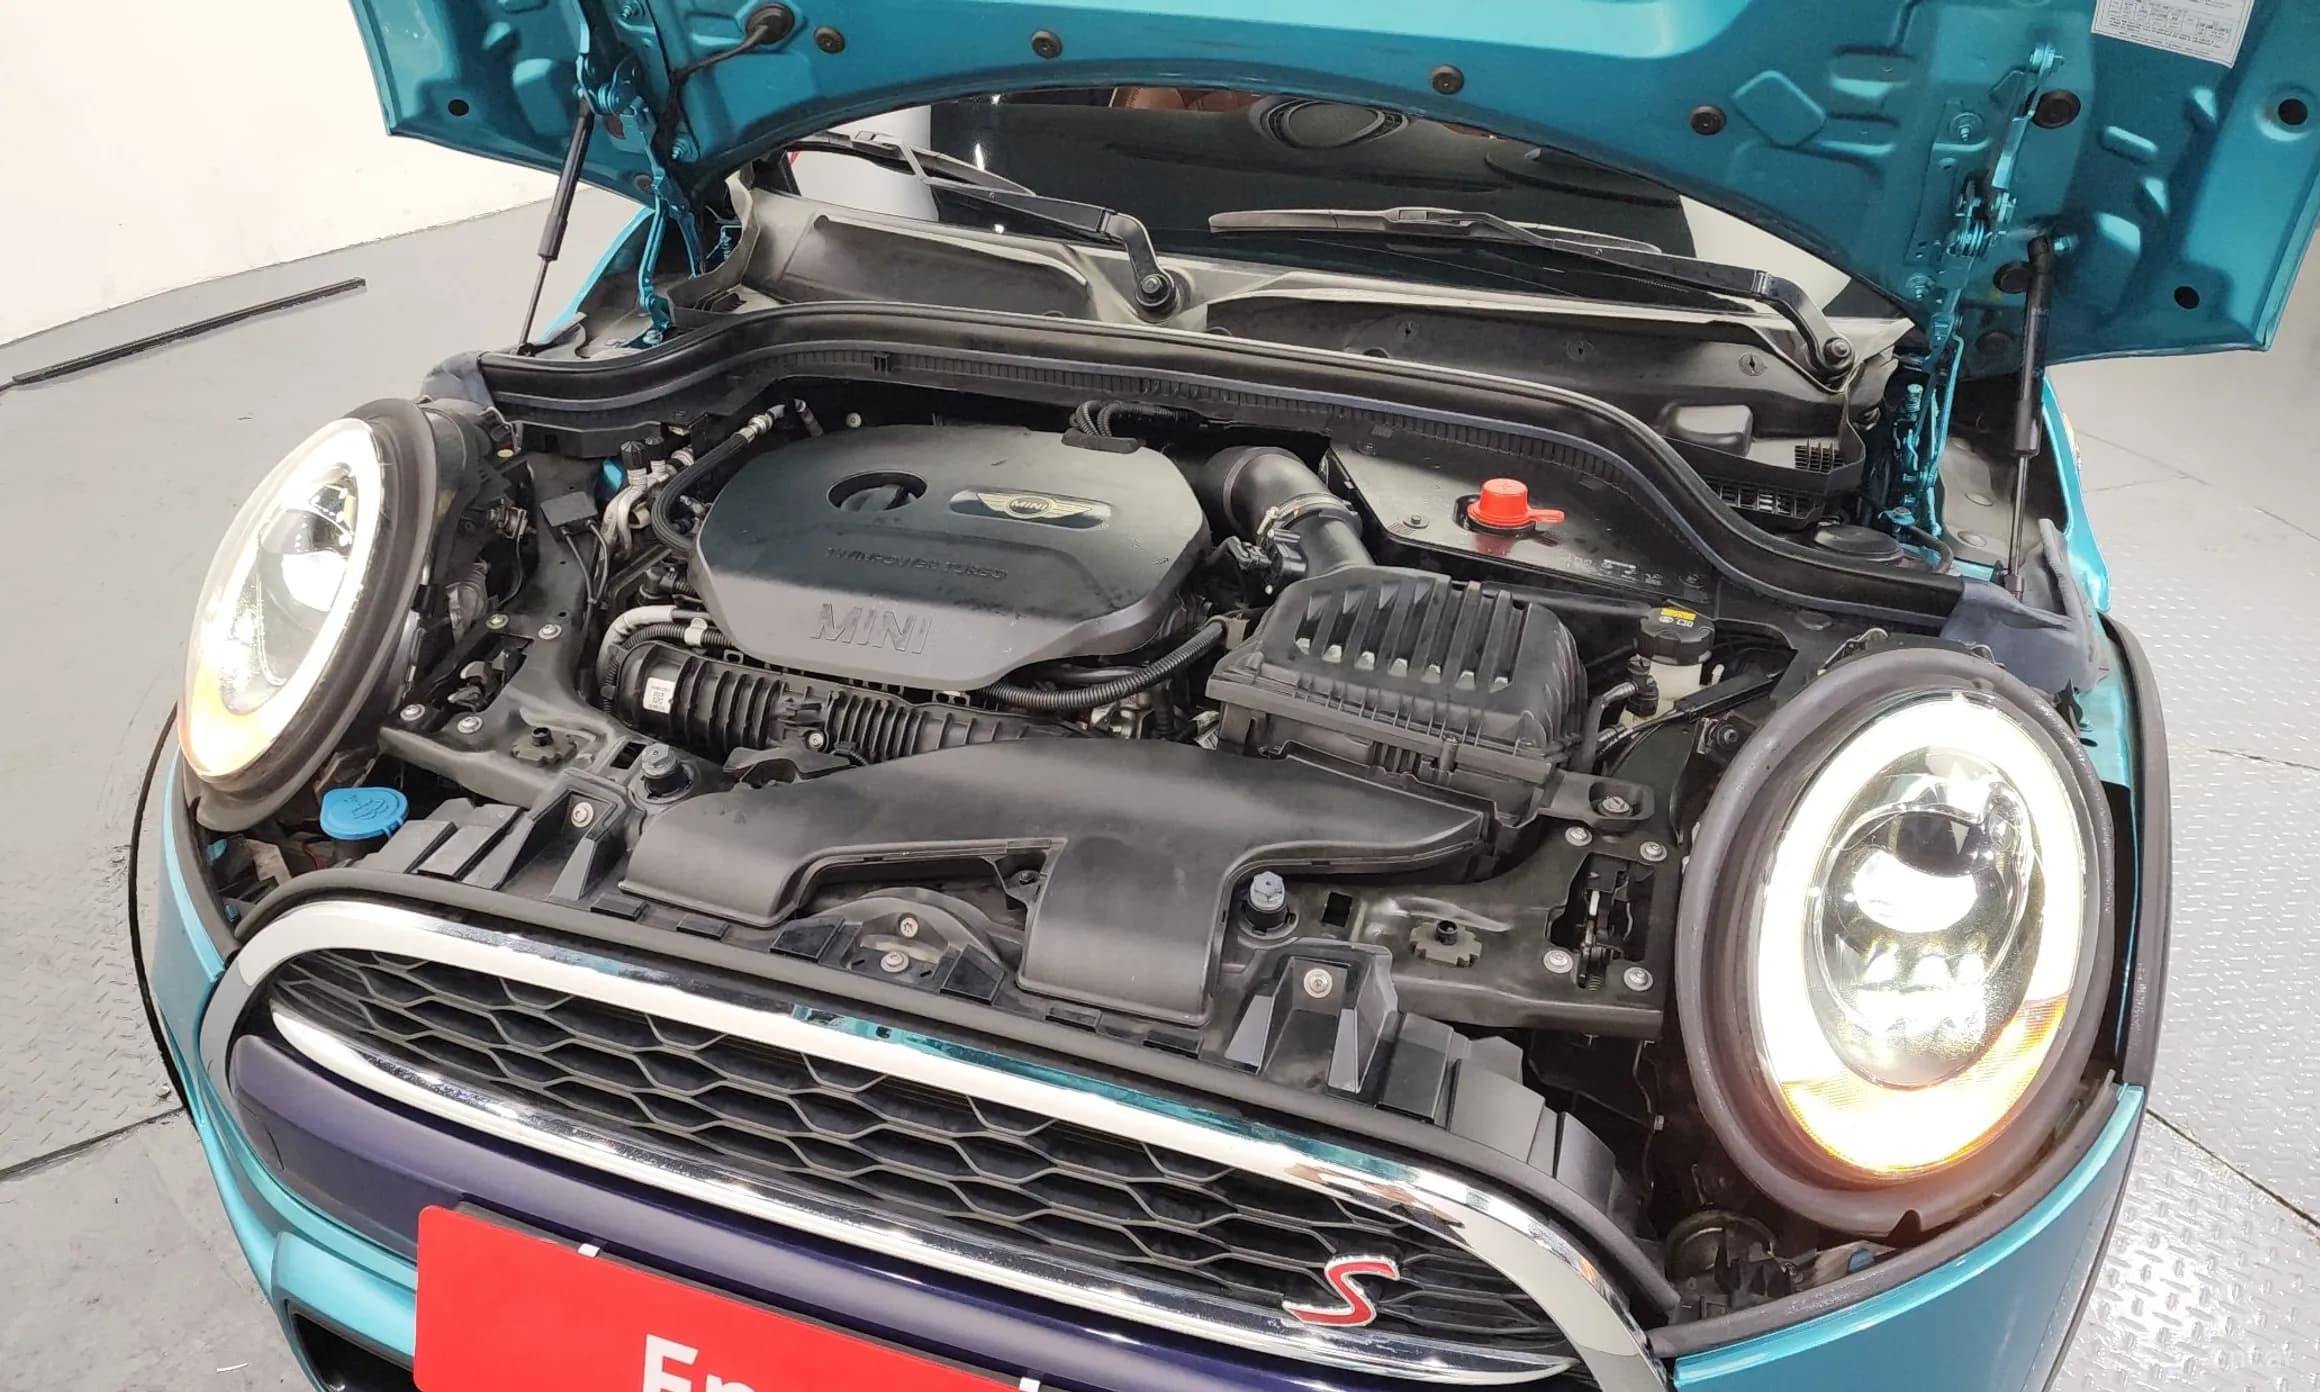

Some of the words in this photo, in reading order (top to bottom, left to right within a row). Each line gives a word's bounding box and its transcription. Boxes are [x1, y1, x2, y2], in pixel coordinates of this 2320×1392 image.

[1011, 500, 1049, 510] MINI
[810, 603, 933, 655] MINI
[1282, 1254, 1400, 1327] S
[642, 1333, 757, 1392] E
